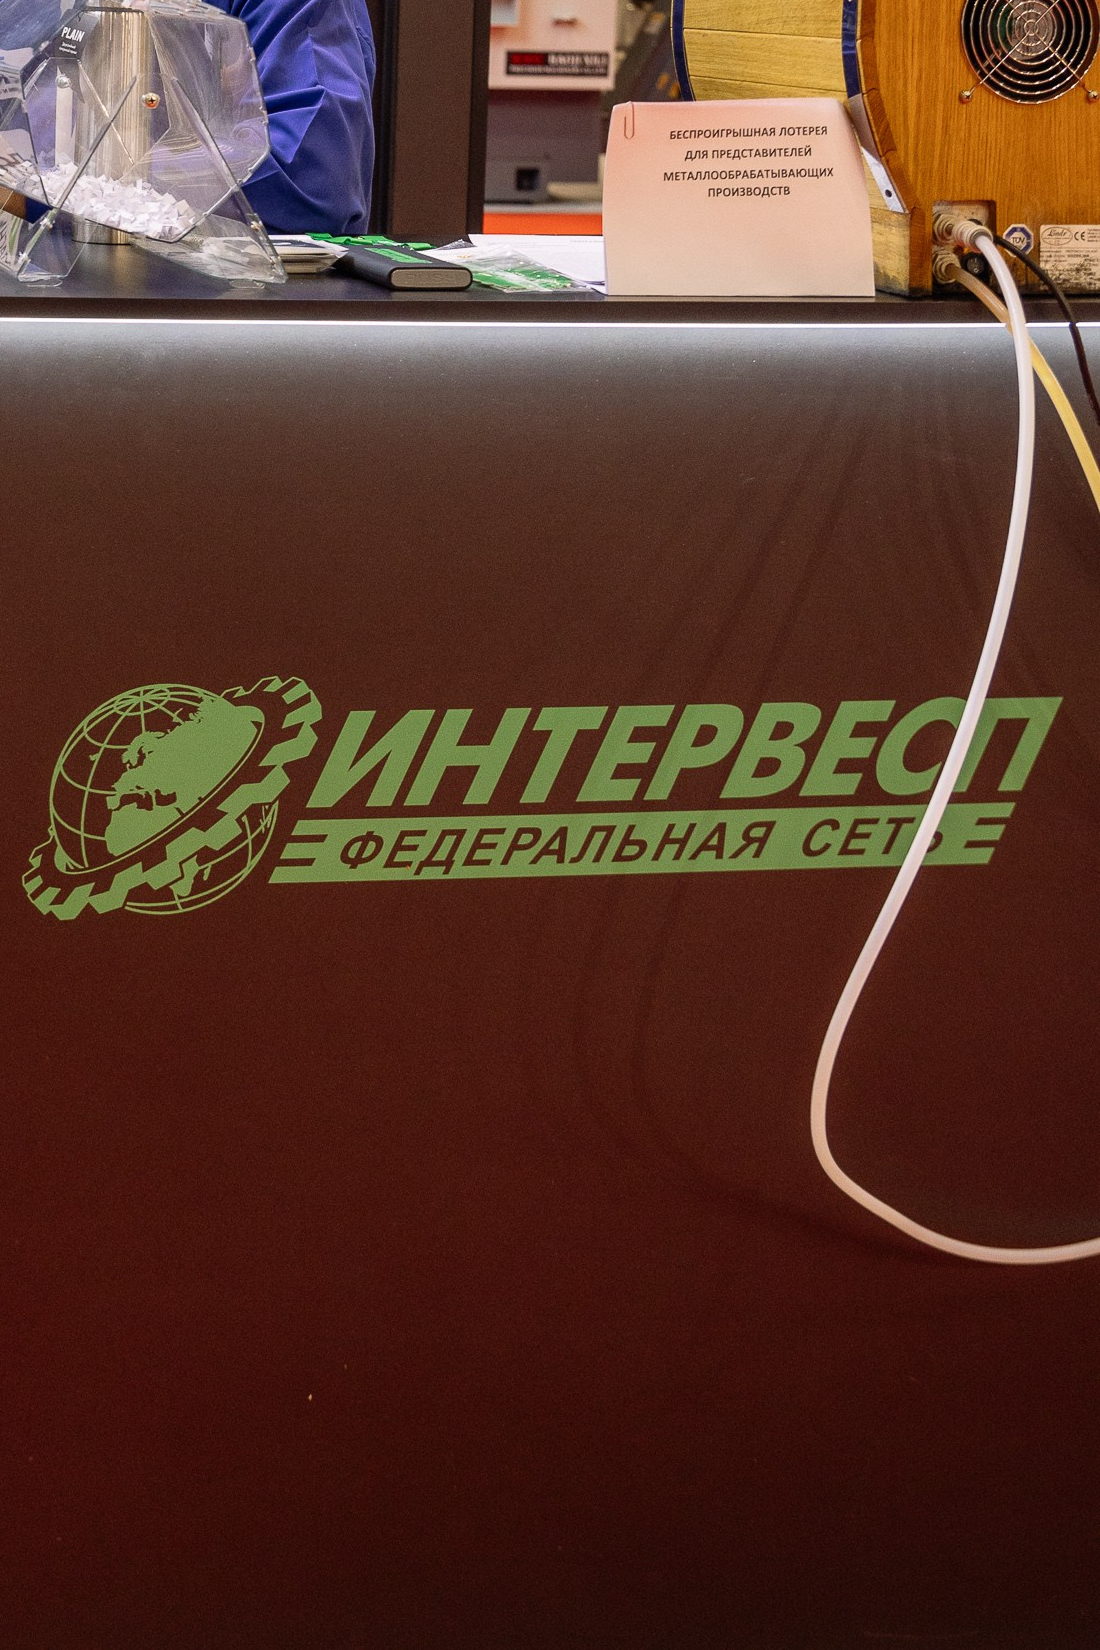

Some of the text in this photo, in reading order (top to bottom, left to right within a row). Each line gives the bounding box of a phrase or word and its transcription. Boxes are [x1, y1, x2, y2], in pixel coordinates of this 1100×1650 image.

[61, 26, 86, 43] PLAIN
[669, 125, 828, 140] БЕСПРОИГРЫШНАЯ ЛОТЕРЕЯ
[683, 144, 812, 162] ДЛЯ ПРЕДСТАВИТЕЛЕЙ
[663, 167, 834, 182] МЕТАЛЛООБРАБАТЫВАЮЩИХ
[707, 185, 791, 198] ПРОИЗВОДСТВ
[307, 696, 1064, 808] ИНТЕРВЕСП
[339, 821, 775, 878] ФЕДЕРАЛЬНАЯ
